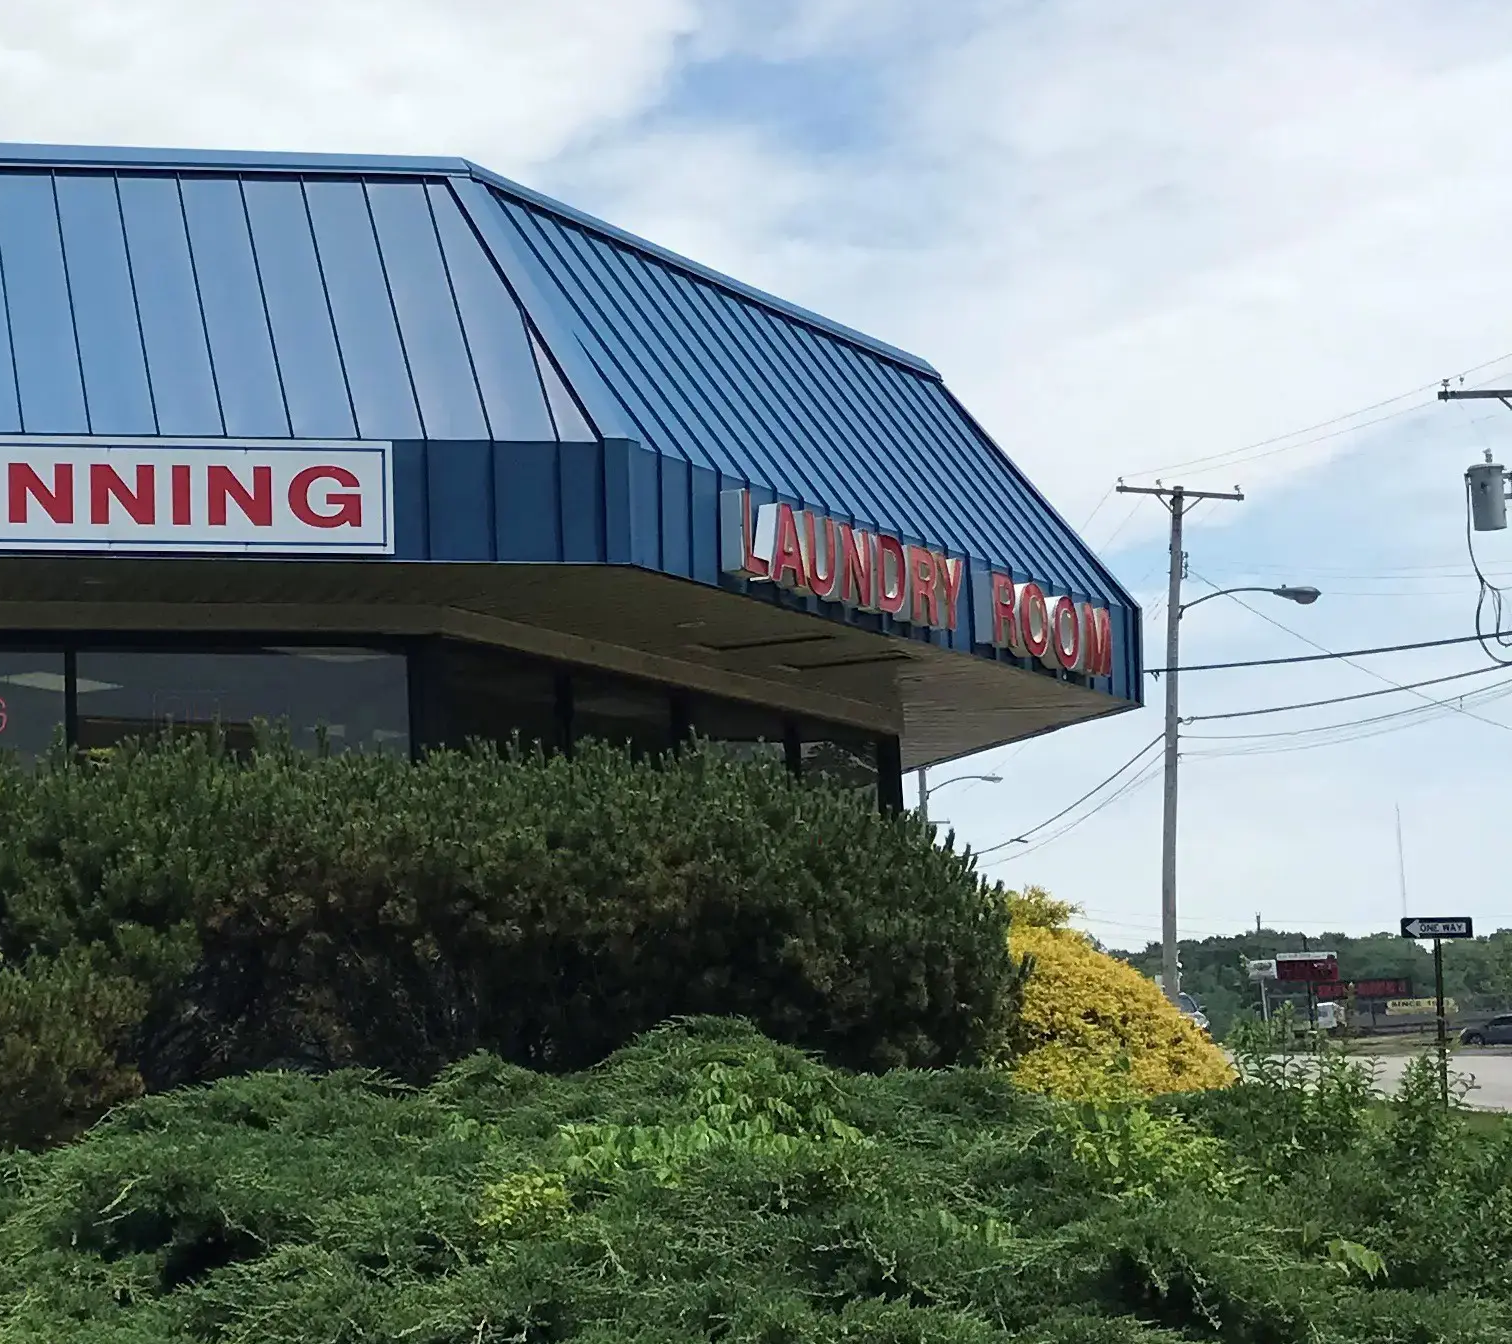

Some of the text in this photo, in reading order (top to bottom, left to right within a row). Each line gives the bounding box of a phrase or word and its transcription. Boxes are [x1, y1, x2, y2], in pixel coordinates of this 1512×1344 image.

[742, 487, 1113, 677] LAUNDRY ROOM
[1419, 923, 1463, 933] ONE WAY
